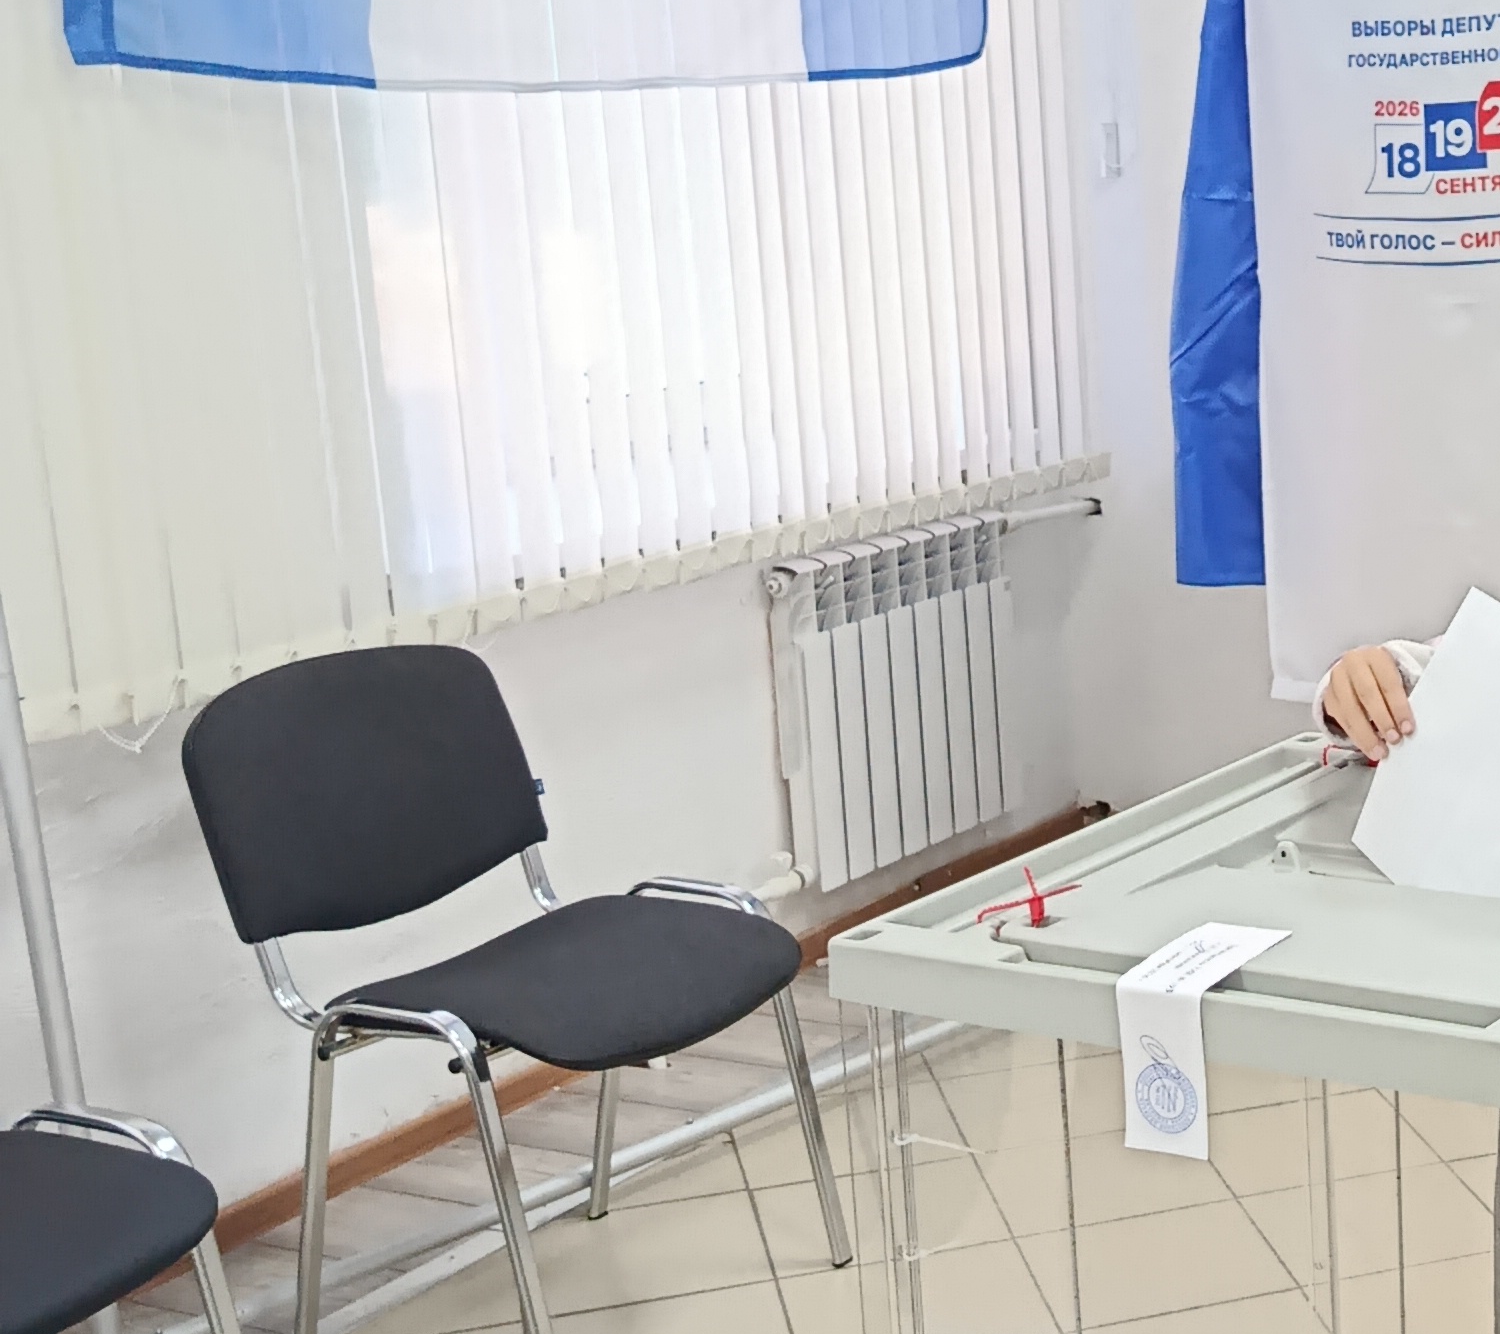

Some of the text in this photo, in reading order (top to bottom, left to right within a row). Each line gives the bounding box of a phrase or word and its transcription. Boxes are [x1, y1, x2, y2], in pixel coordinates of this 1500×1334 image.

[1352, 16, 1437, 37] ВЫБОРЫ
[1374, 100, 1420, 117] 2026
[1381, 143, 1421, 178] 18
[1429, 119, 1473, 157] 19
[1327, 230, 1365, 249] ТВОЙ
[1370, 234, 1435, 251] ГОЛОС
